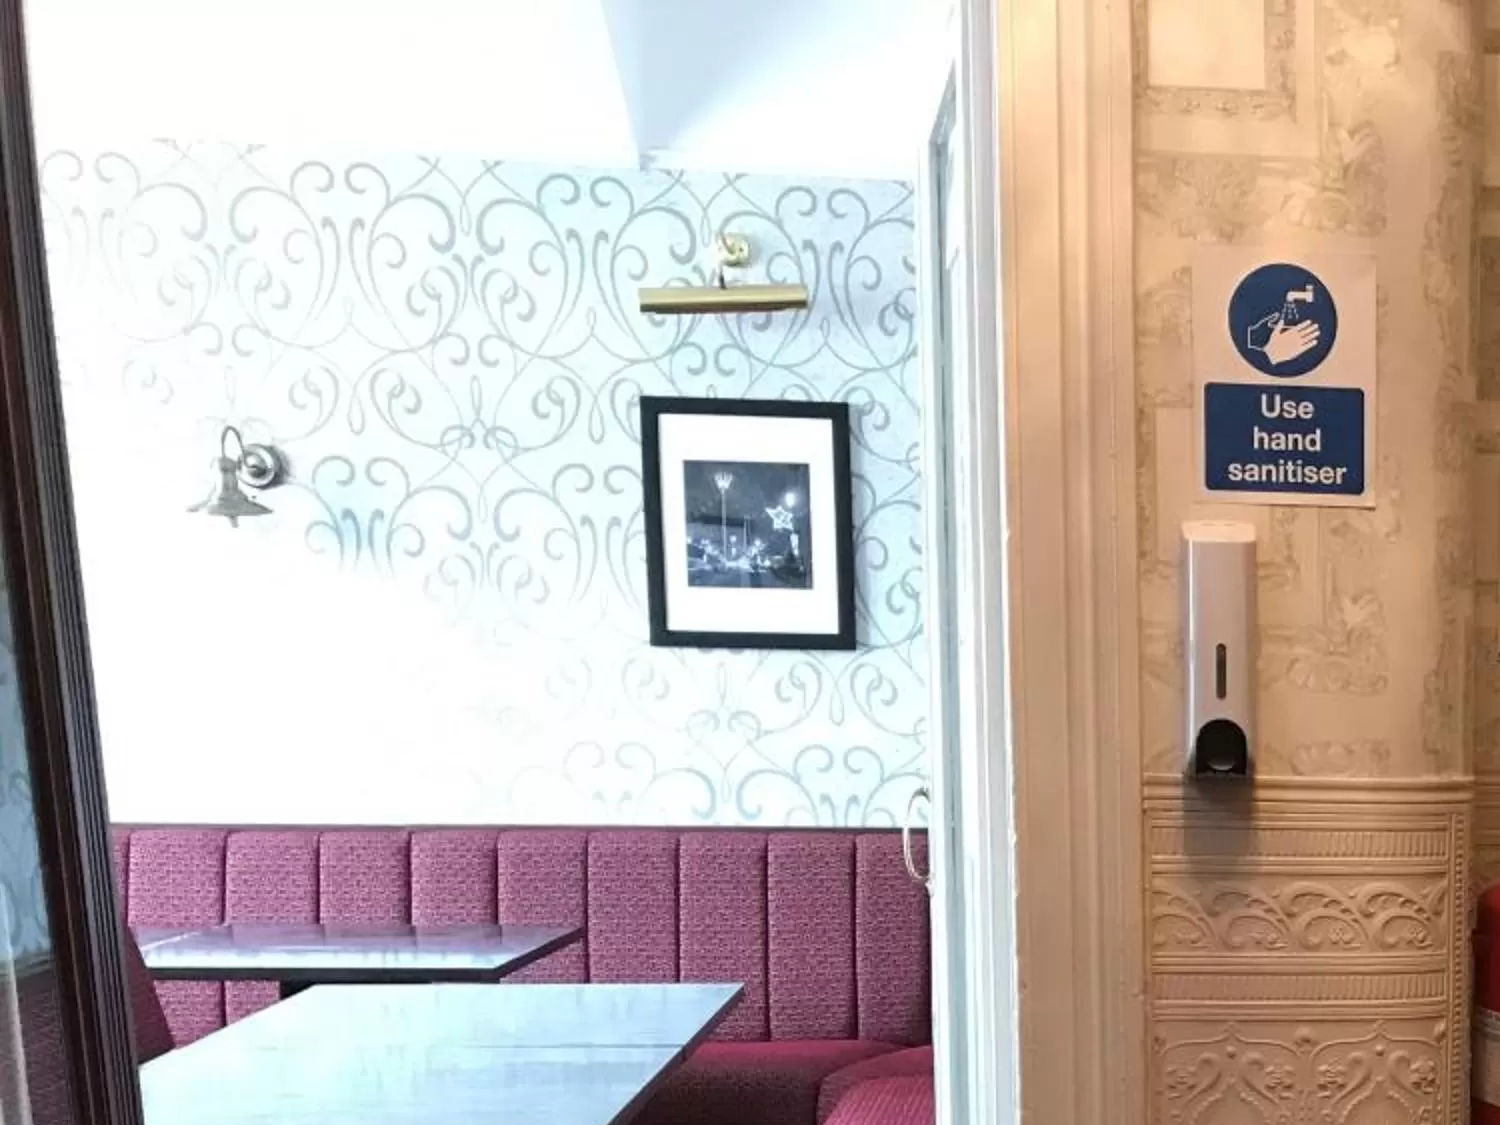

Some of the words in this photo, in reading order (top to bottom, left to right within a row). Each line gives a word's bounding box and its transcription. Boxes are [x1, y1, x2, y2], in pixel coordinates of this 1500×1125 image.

[1261, 393, 1315, 419] Use
[1253, 425, 1321, 451] hand
[1228, 459, 1347, 484] sanitiser
